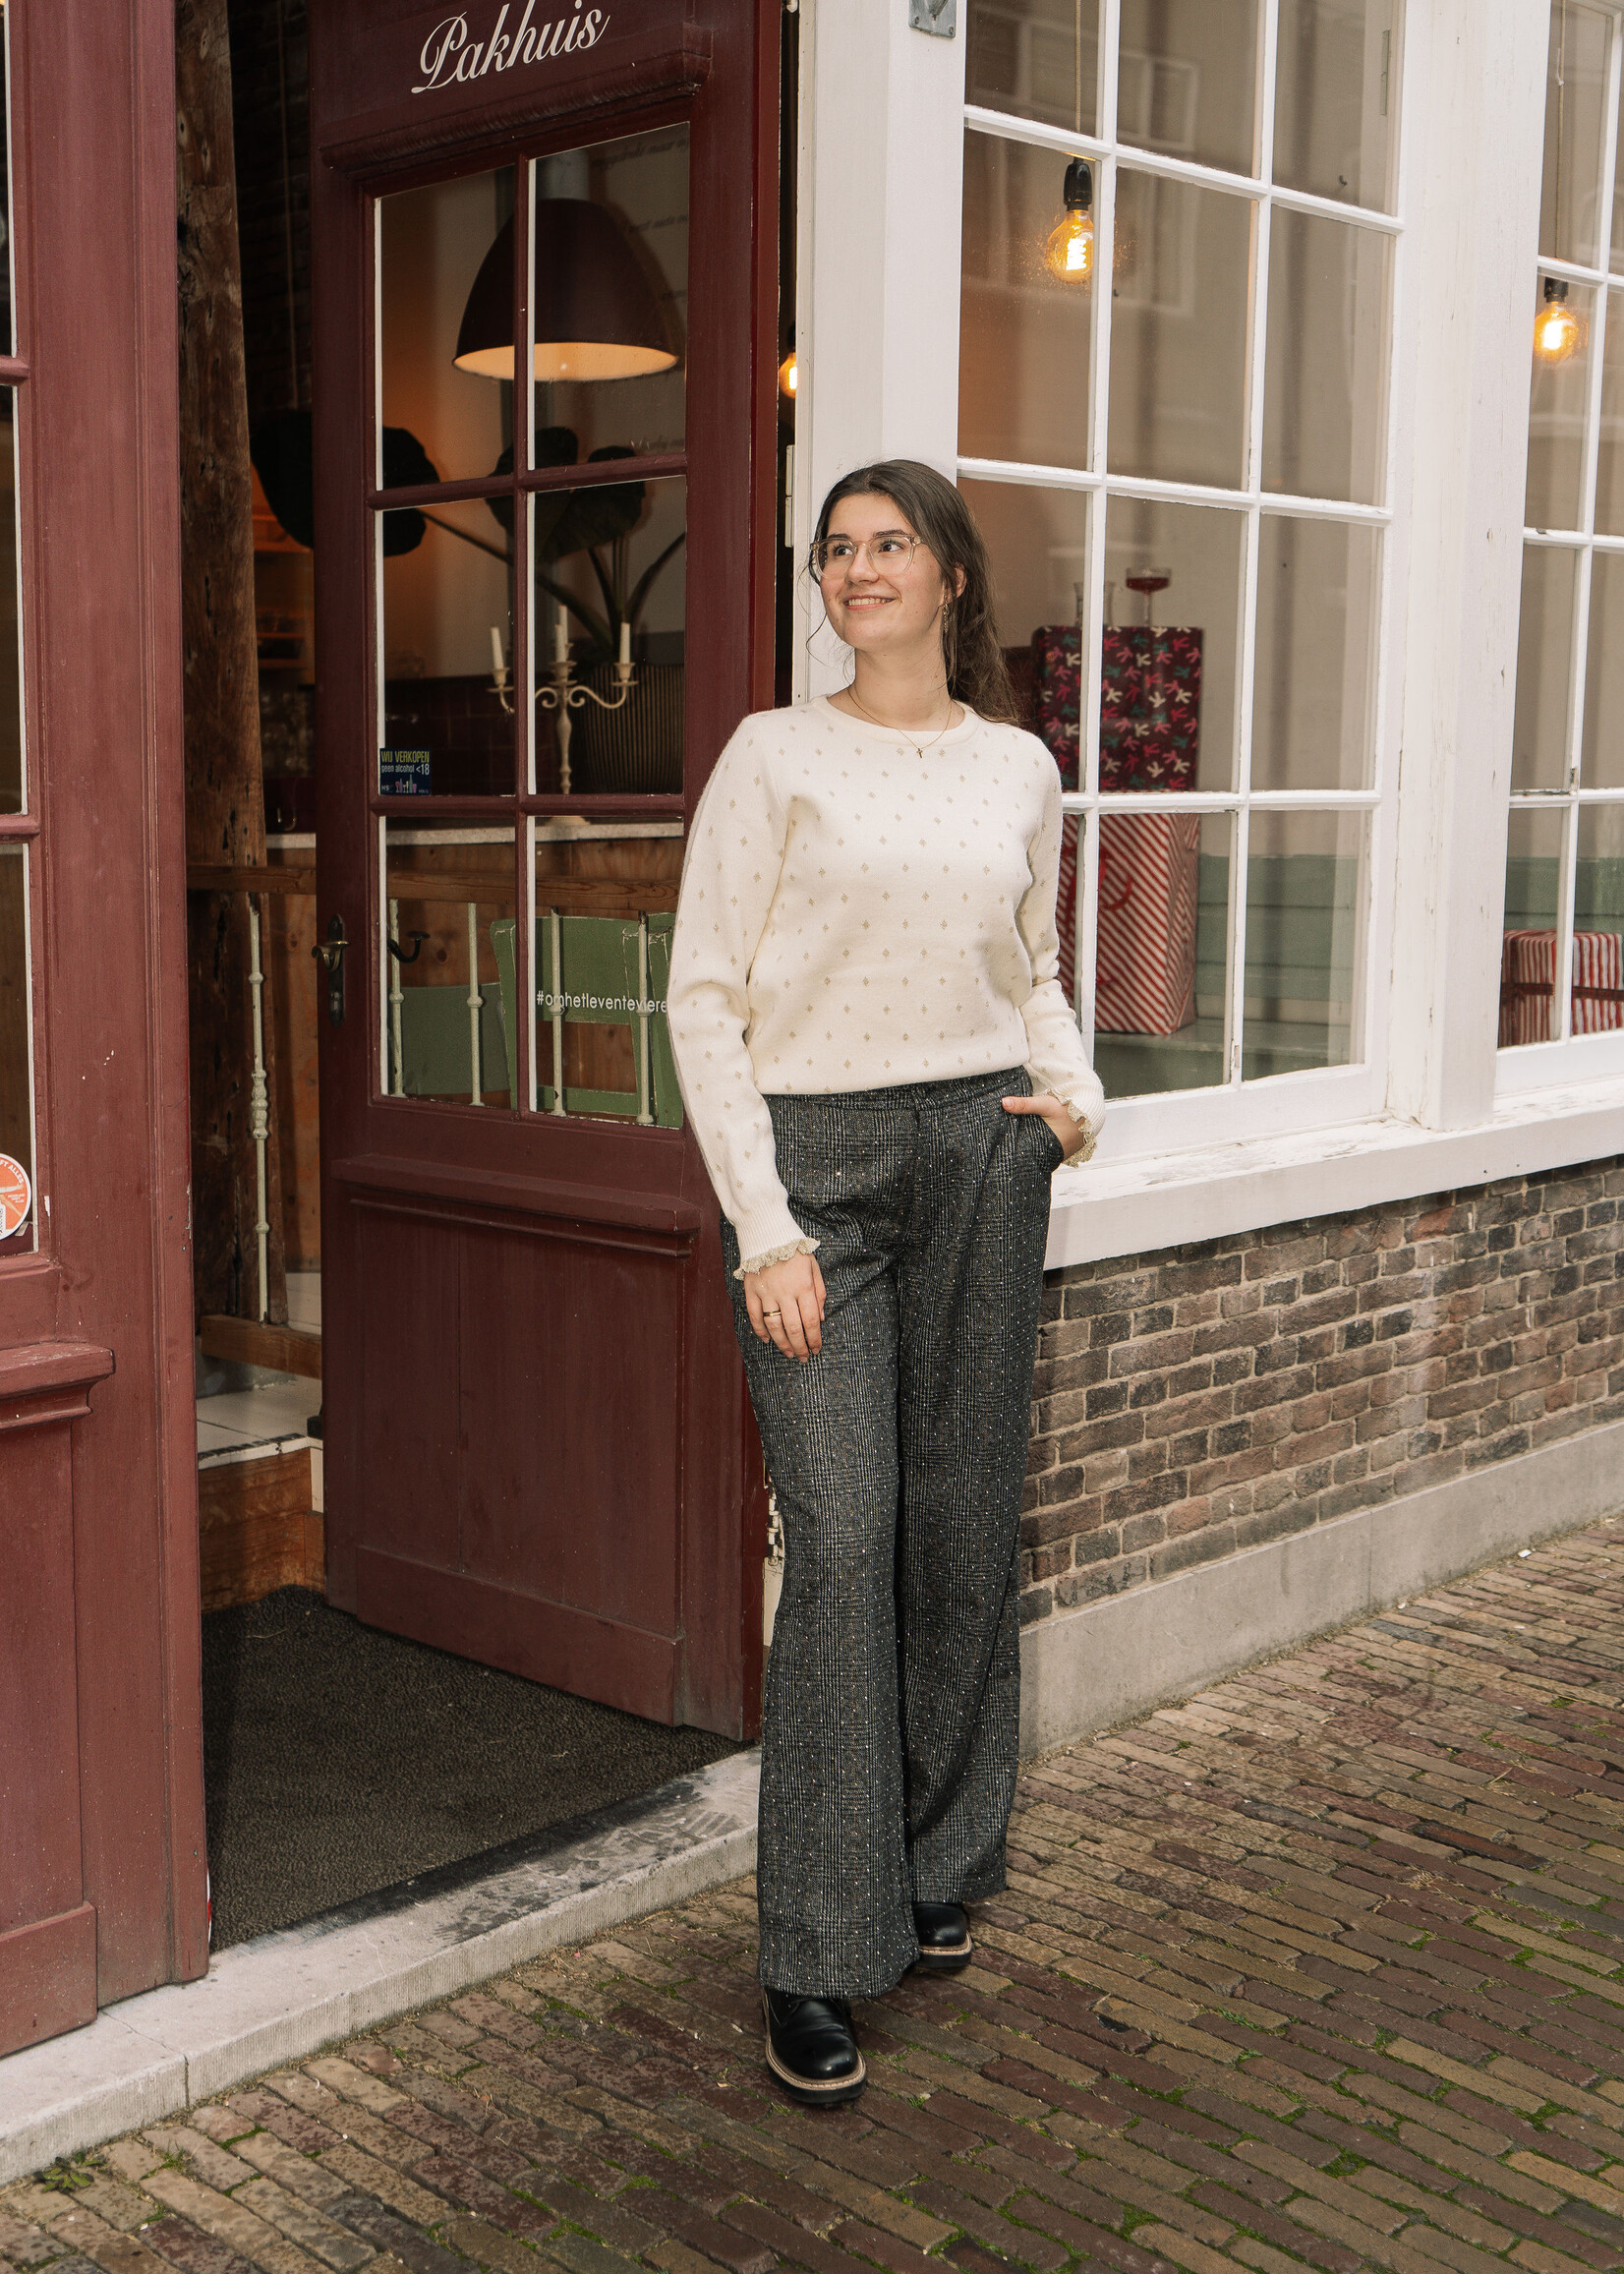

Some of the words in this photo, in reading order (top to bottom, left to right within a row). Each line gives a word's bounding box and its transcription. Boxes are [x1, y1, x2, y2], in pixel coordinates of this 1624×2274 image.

[411, 0, 610, 93] Pakhuis
[381, 751, 392, 763] WIJ
[395, 751, 430, 763] VERKOPEN
[395, 764, 415, 773] alcohol
[416, 764, 430, 775] <18
[8, 1165, 24, 1184] ALLES
